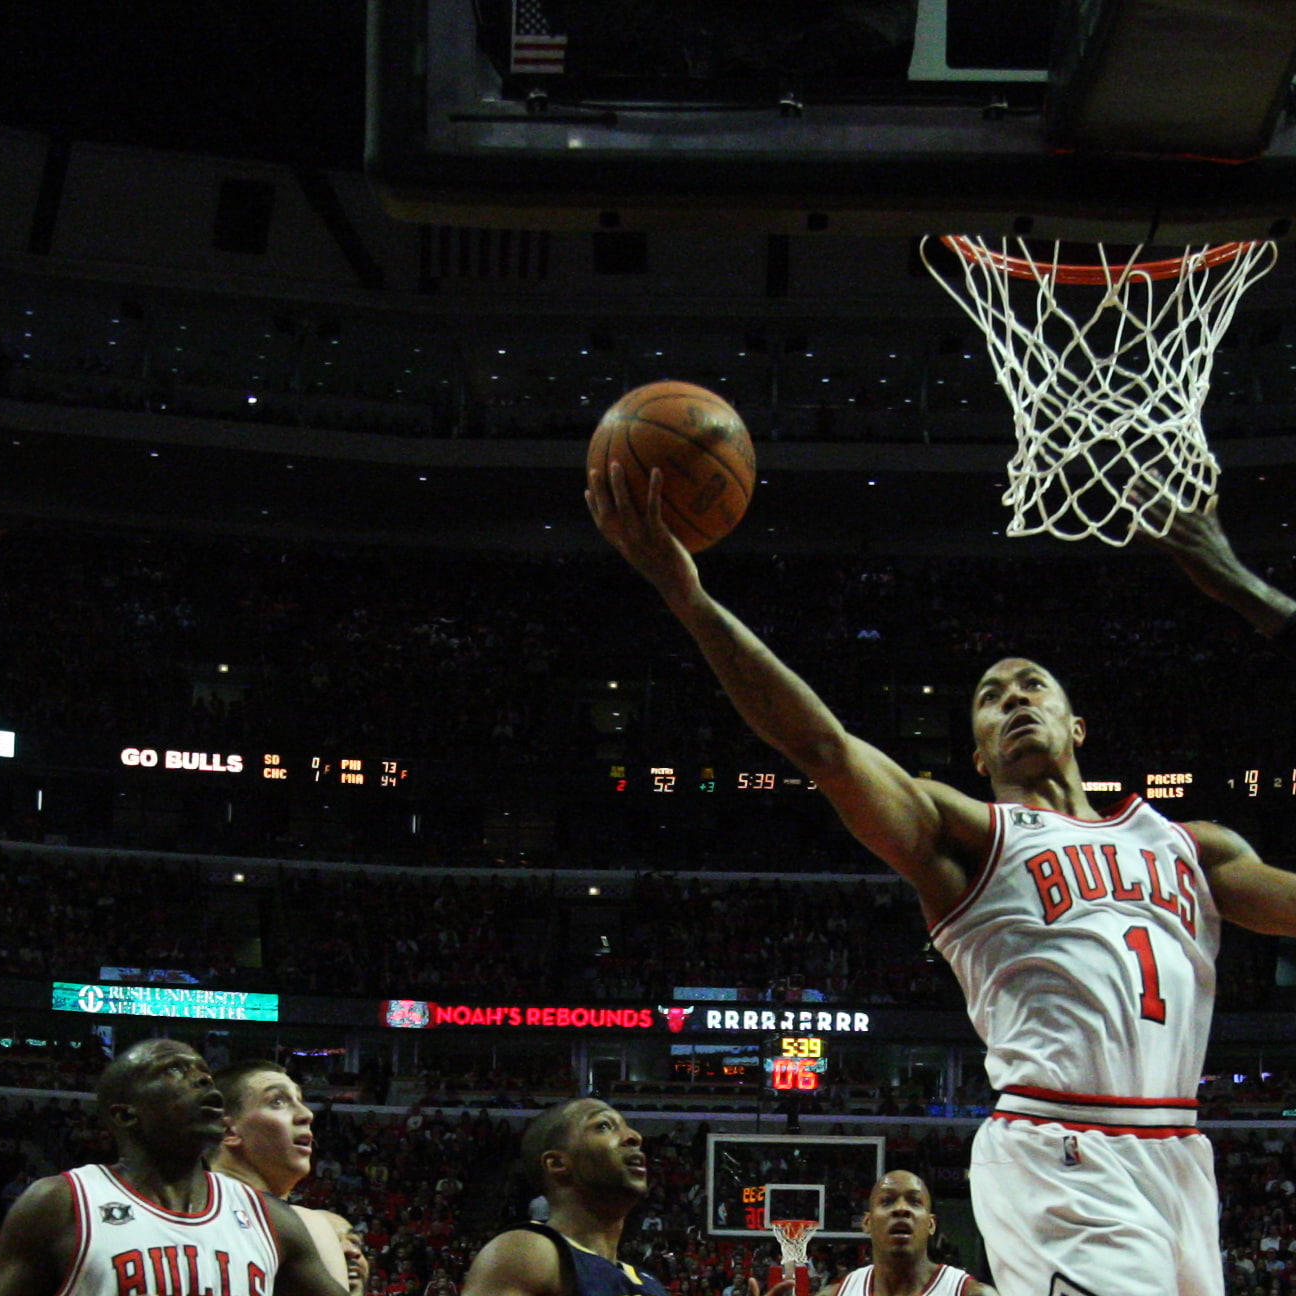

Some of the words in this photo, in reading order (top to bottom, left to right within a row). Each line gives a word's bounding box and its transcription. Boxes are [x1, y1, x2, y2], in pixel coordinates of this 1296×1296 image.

[121, 748, 158, 767] GO
[165, 750, 243, 773] BULLS
[341, 759, 362, 771] PHI
[381, 761, 397, 774] 73
[263, 768, 287, 780] CHC
[341, 773, 364, 785] MIA
[653, 776, 677, 792] 52
[737, 773, 776, 790] 5:39
[1146, 773, 1193, 786] PACERS
[1244, 769, 1259, 784] 10
[1146, 787, 1184, 799] BULLS
[1025, 844, 1196, 941] BULLS
[1123, 925, 1166, 1026] 1
[109, 985, 148, 1000] RUSH
[155, 988, 249, 1005] UNIVERSITY
[109, 1001, 180, 1016] MEDICAL
[184, 1003, 248, 1020] CENTER
[436, 1005, 522, 1026] NOAH'S
[526, 1007, 653, 1028] REBOUNDS
[782, 1037, 822, 1058] 5:39
[774, 1059, 819, 1090] 06
